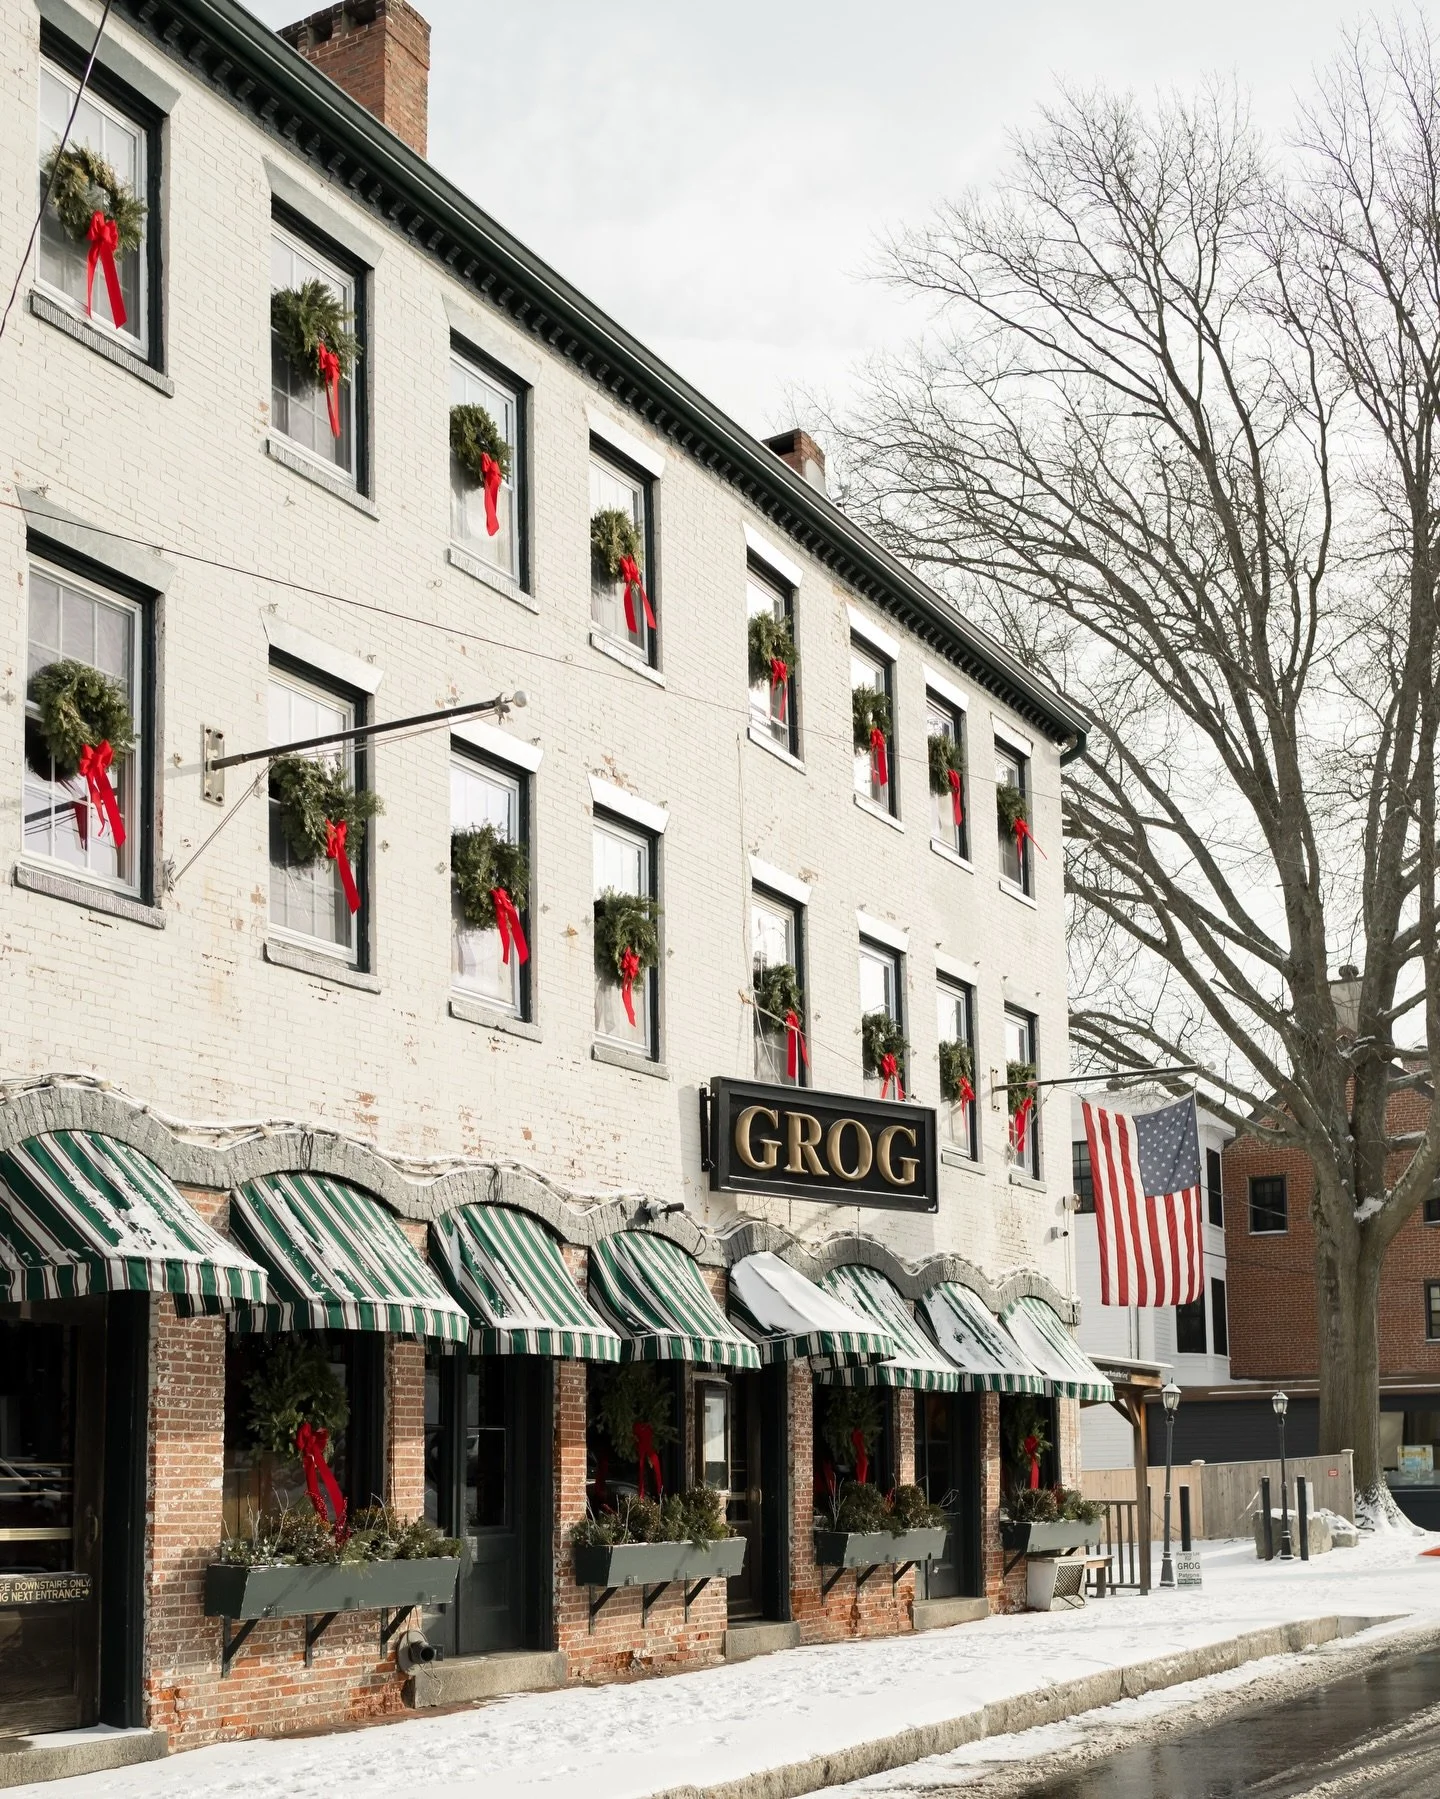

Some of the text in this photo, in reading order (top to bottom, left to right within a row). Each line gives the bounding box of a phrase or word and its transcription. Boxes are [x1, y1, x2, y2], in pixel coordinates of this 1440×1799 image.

[735, 1105, 920, 1186] GROG
[1177, 1562, 1201, 1570] GROG
[15, 1580, 67, 1591] DOWNSTAIRS
[11, 1591, 33, 1602] NEXT
[36, 1588, 81, 1600] ENTRANCE
